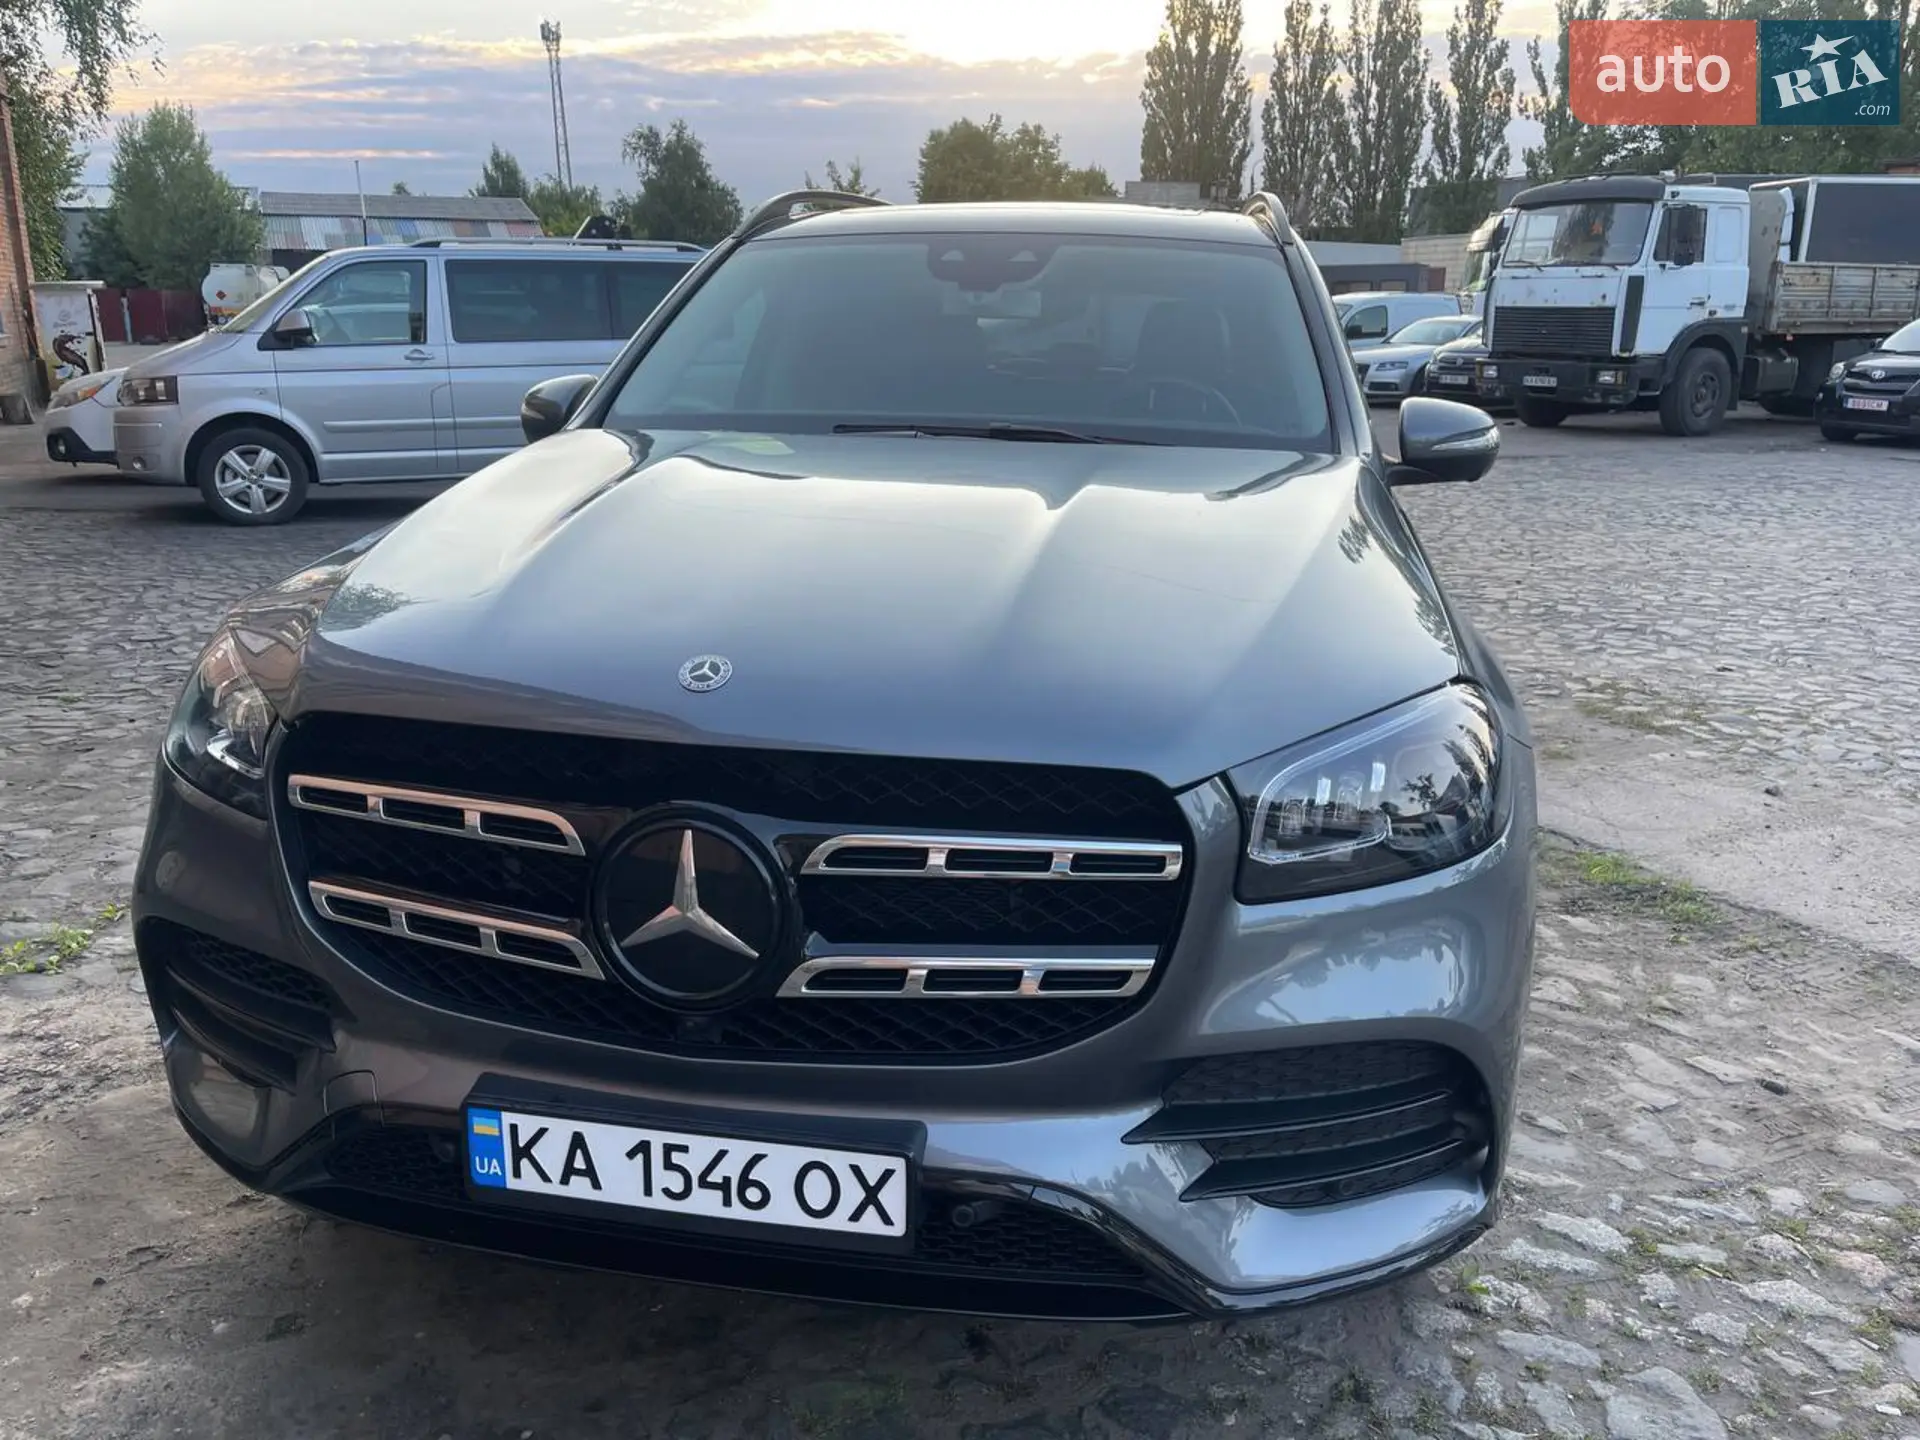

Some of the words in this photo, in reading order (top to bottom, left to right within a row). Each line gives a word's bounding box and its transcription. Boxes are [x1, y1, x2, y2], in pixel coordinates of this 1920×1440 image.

[475, 1155, 502, 1176] UA
[509, 1122, 603, 1191] KA
[625, 1139, 772, 1211] 1546
[794, 1160, 896, 1227] OX
